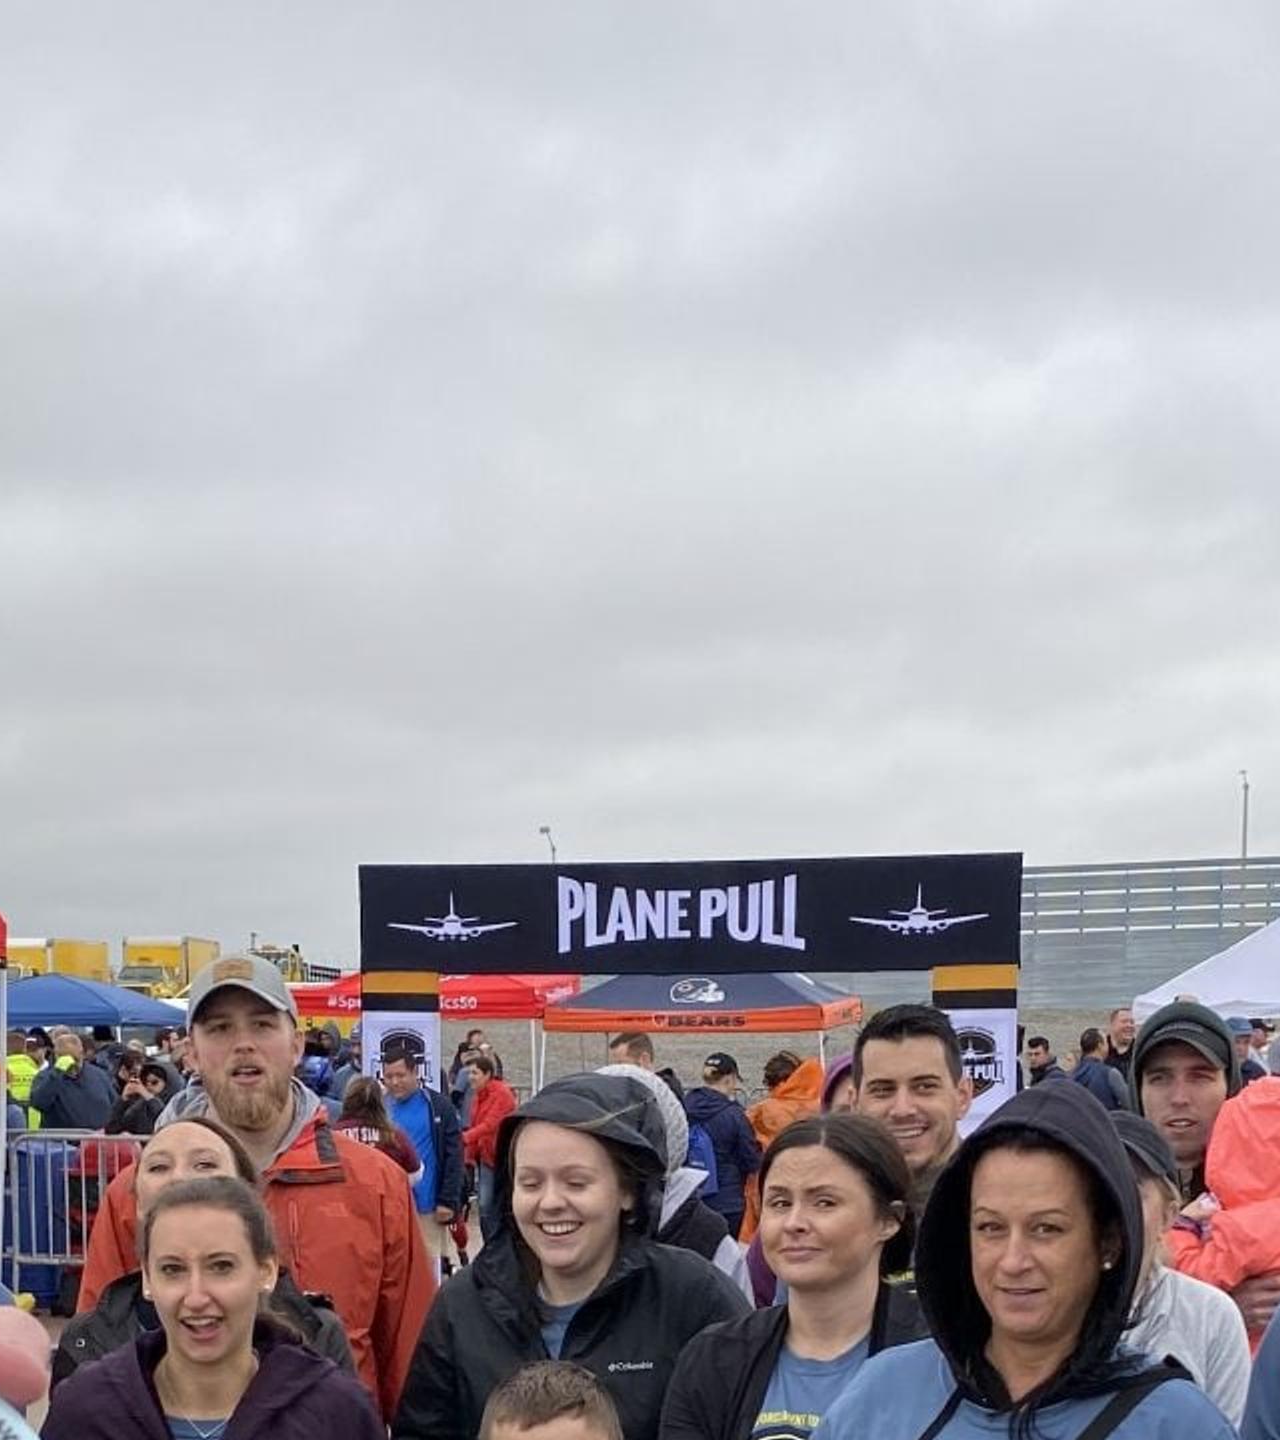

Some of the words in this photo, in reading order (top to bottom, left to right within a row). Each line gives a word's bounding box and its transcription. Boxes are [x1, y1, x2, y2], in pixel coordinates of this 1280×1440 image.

[558, 875, 691, 953] PLANE
[700, 873, 806, 951] PULL
[668, 1015, 746, 1027] BEARS
